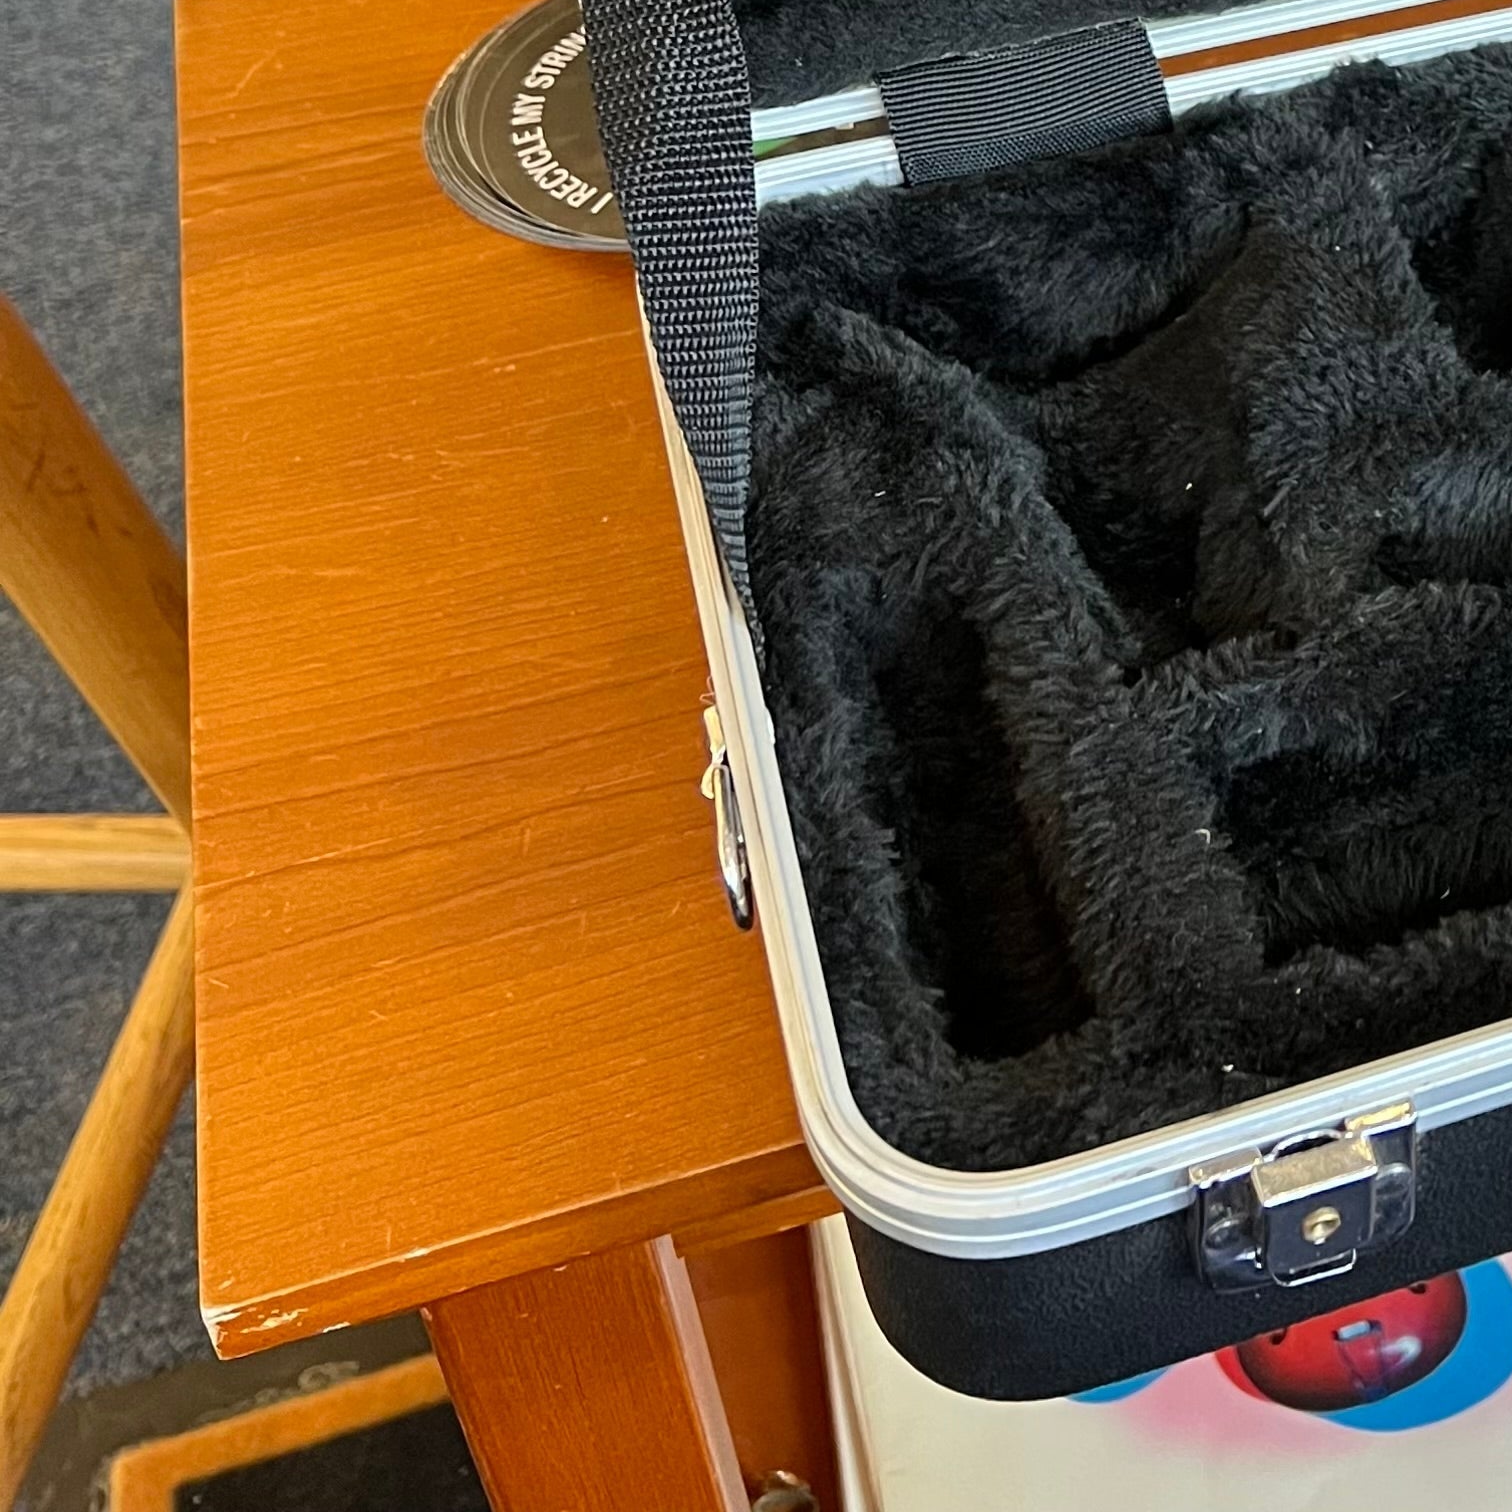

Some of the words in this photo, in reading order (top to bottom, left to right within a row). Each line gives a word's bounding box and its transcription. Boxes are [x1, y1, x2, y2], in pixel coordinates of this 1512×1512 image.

[524, 25, 588, 90] STRIN
[511, 92, 546, 126] MY
[512, 125, 598, 209] RECYCLE
[591, 192, 614, 214] I
